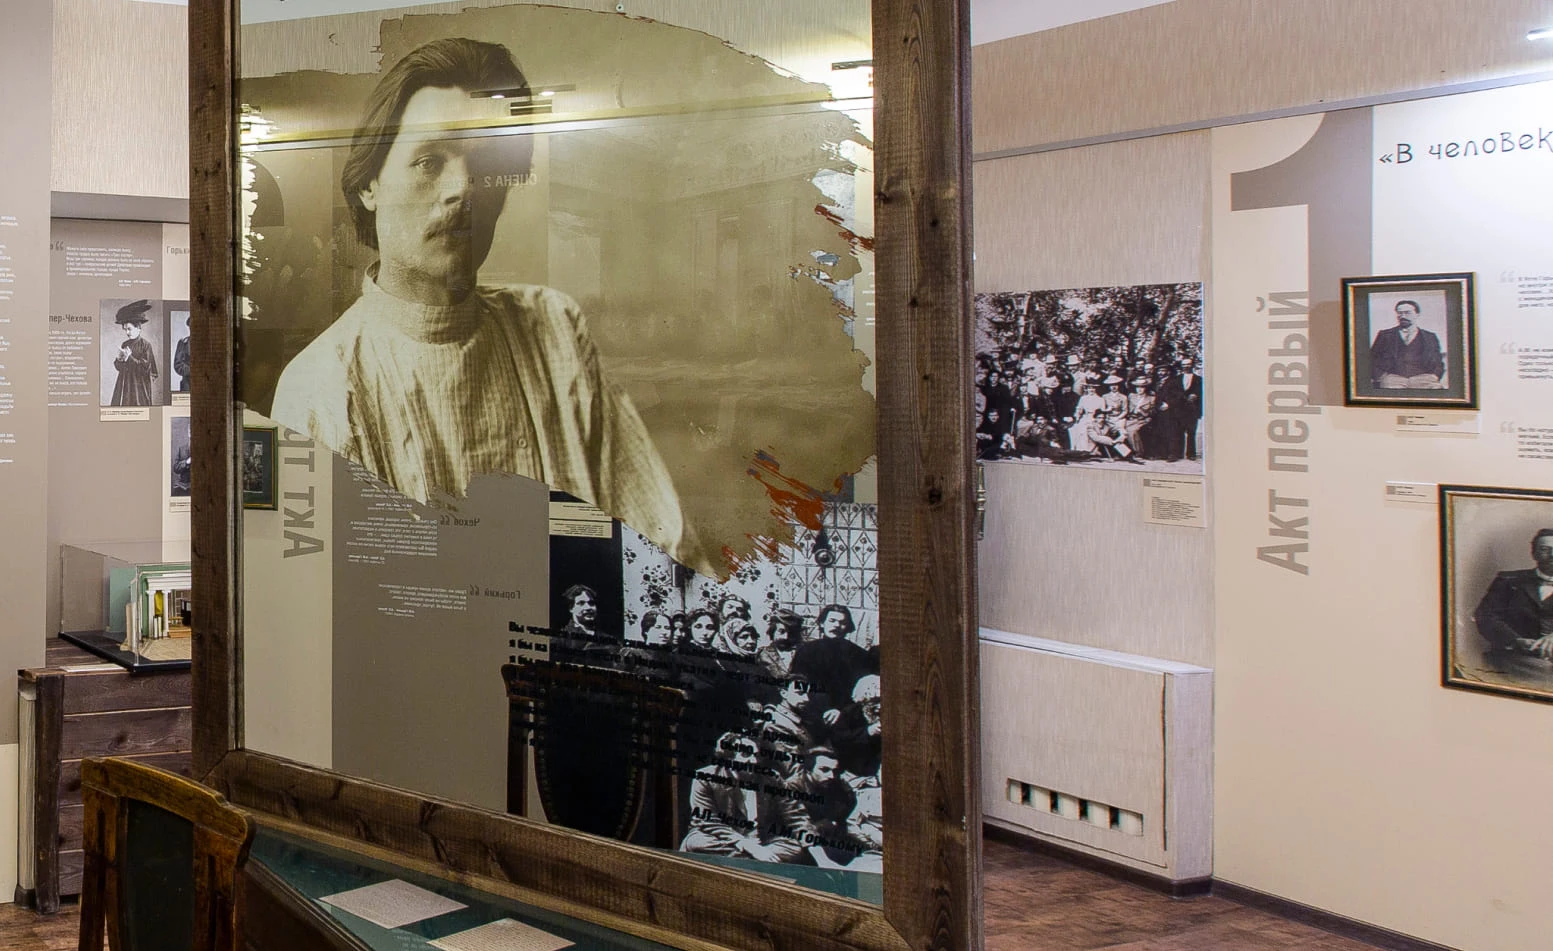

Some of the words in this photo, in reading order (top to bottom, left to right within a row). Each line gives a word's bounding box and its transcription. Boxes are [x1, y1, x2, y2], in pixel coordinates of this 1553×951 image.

[1256, 291, 1322, 472] первый
[1256, 489, 1309, 576] Акт
[509, 621, 524, 632] Вы
